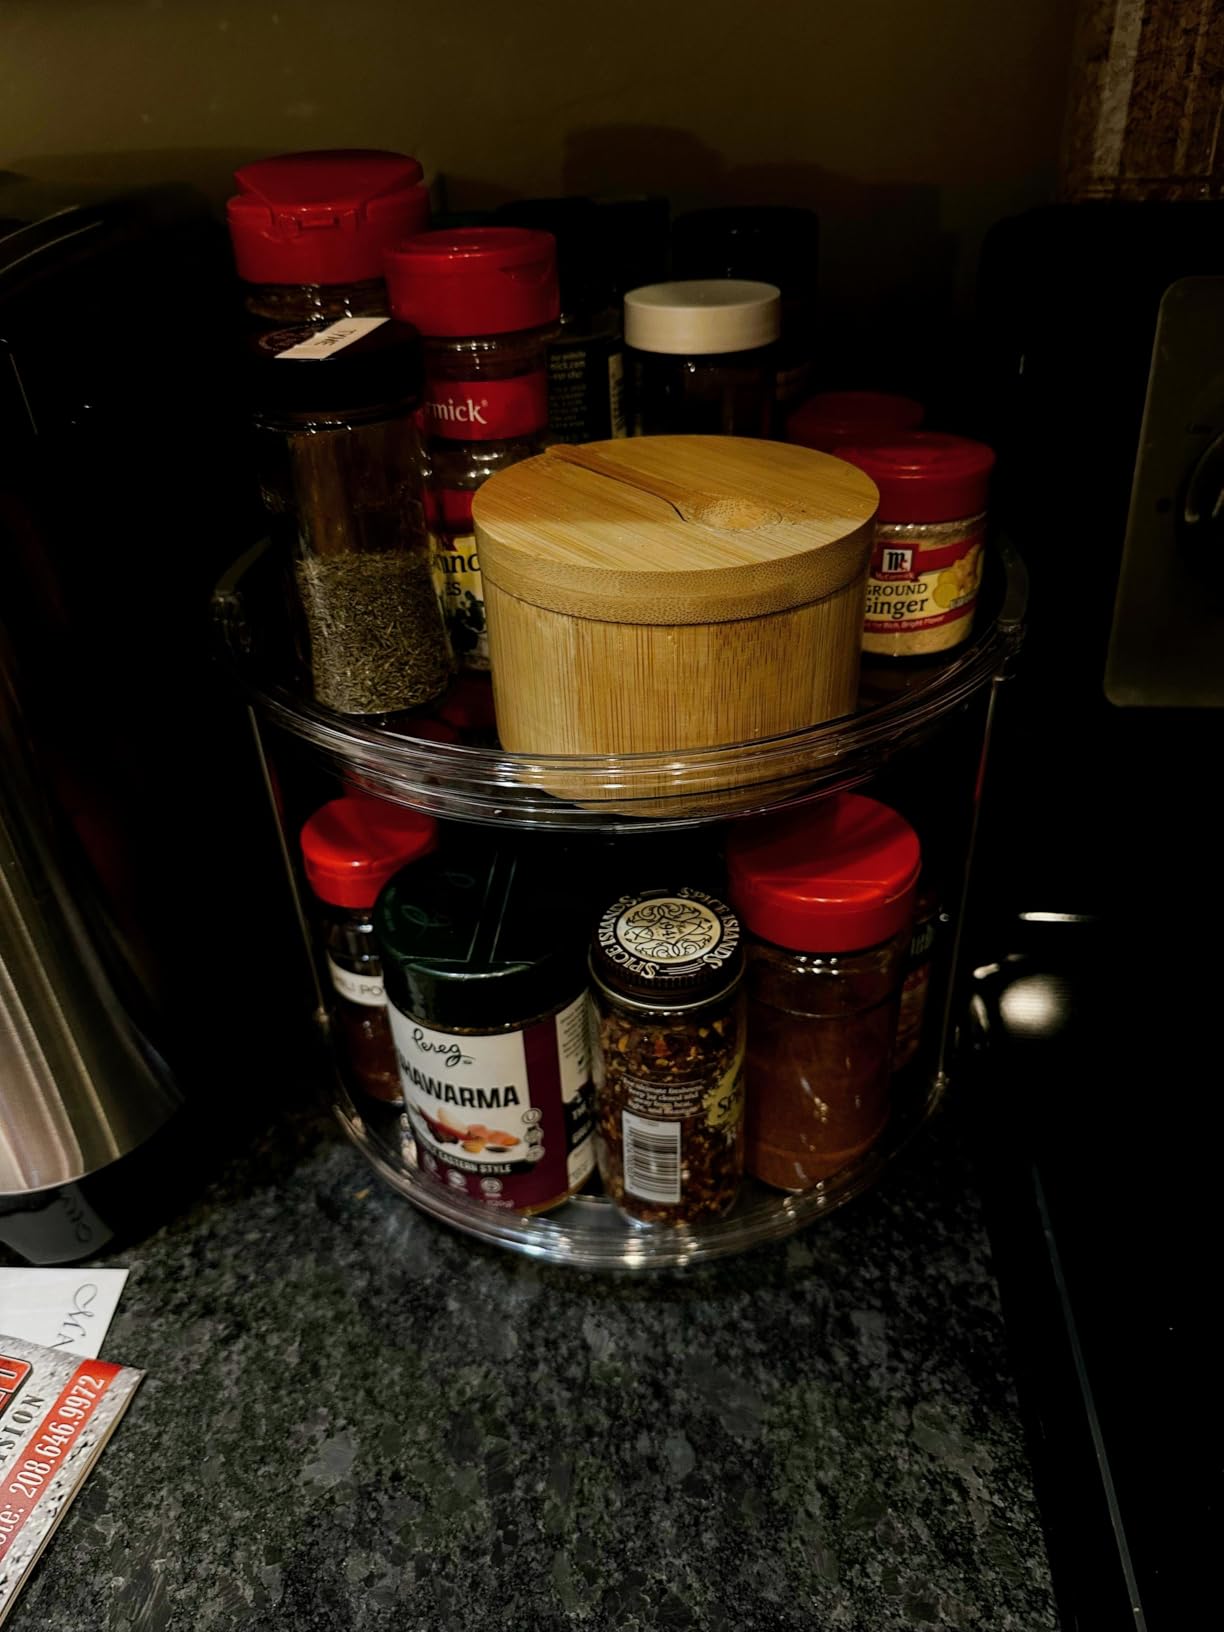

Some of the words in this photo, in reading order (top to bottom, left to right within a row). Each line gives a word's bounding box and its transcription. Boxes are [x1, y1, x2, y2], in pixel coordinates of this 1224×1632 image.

[604, 944, 660, 979] SPICE
[480, 1164, 512, 1174] STYLE
[9, 1374, 105, 1500] 208.646.9972
